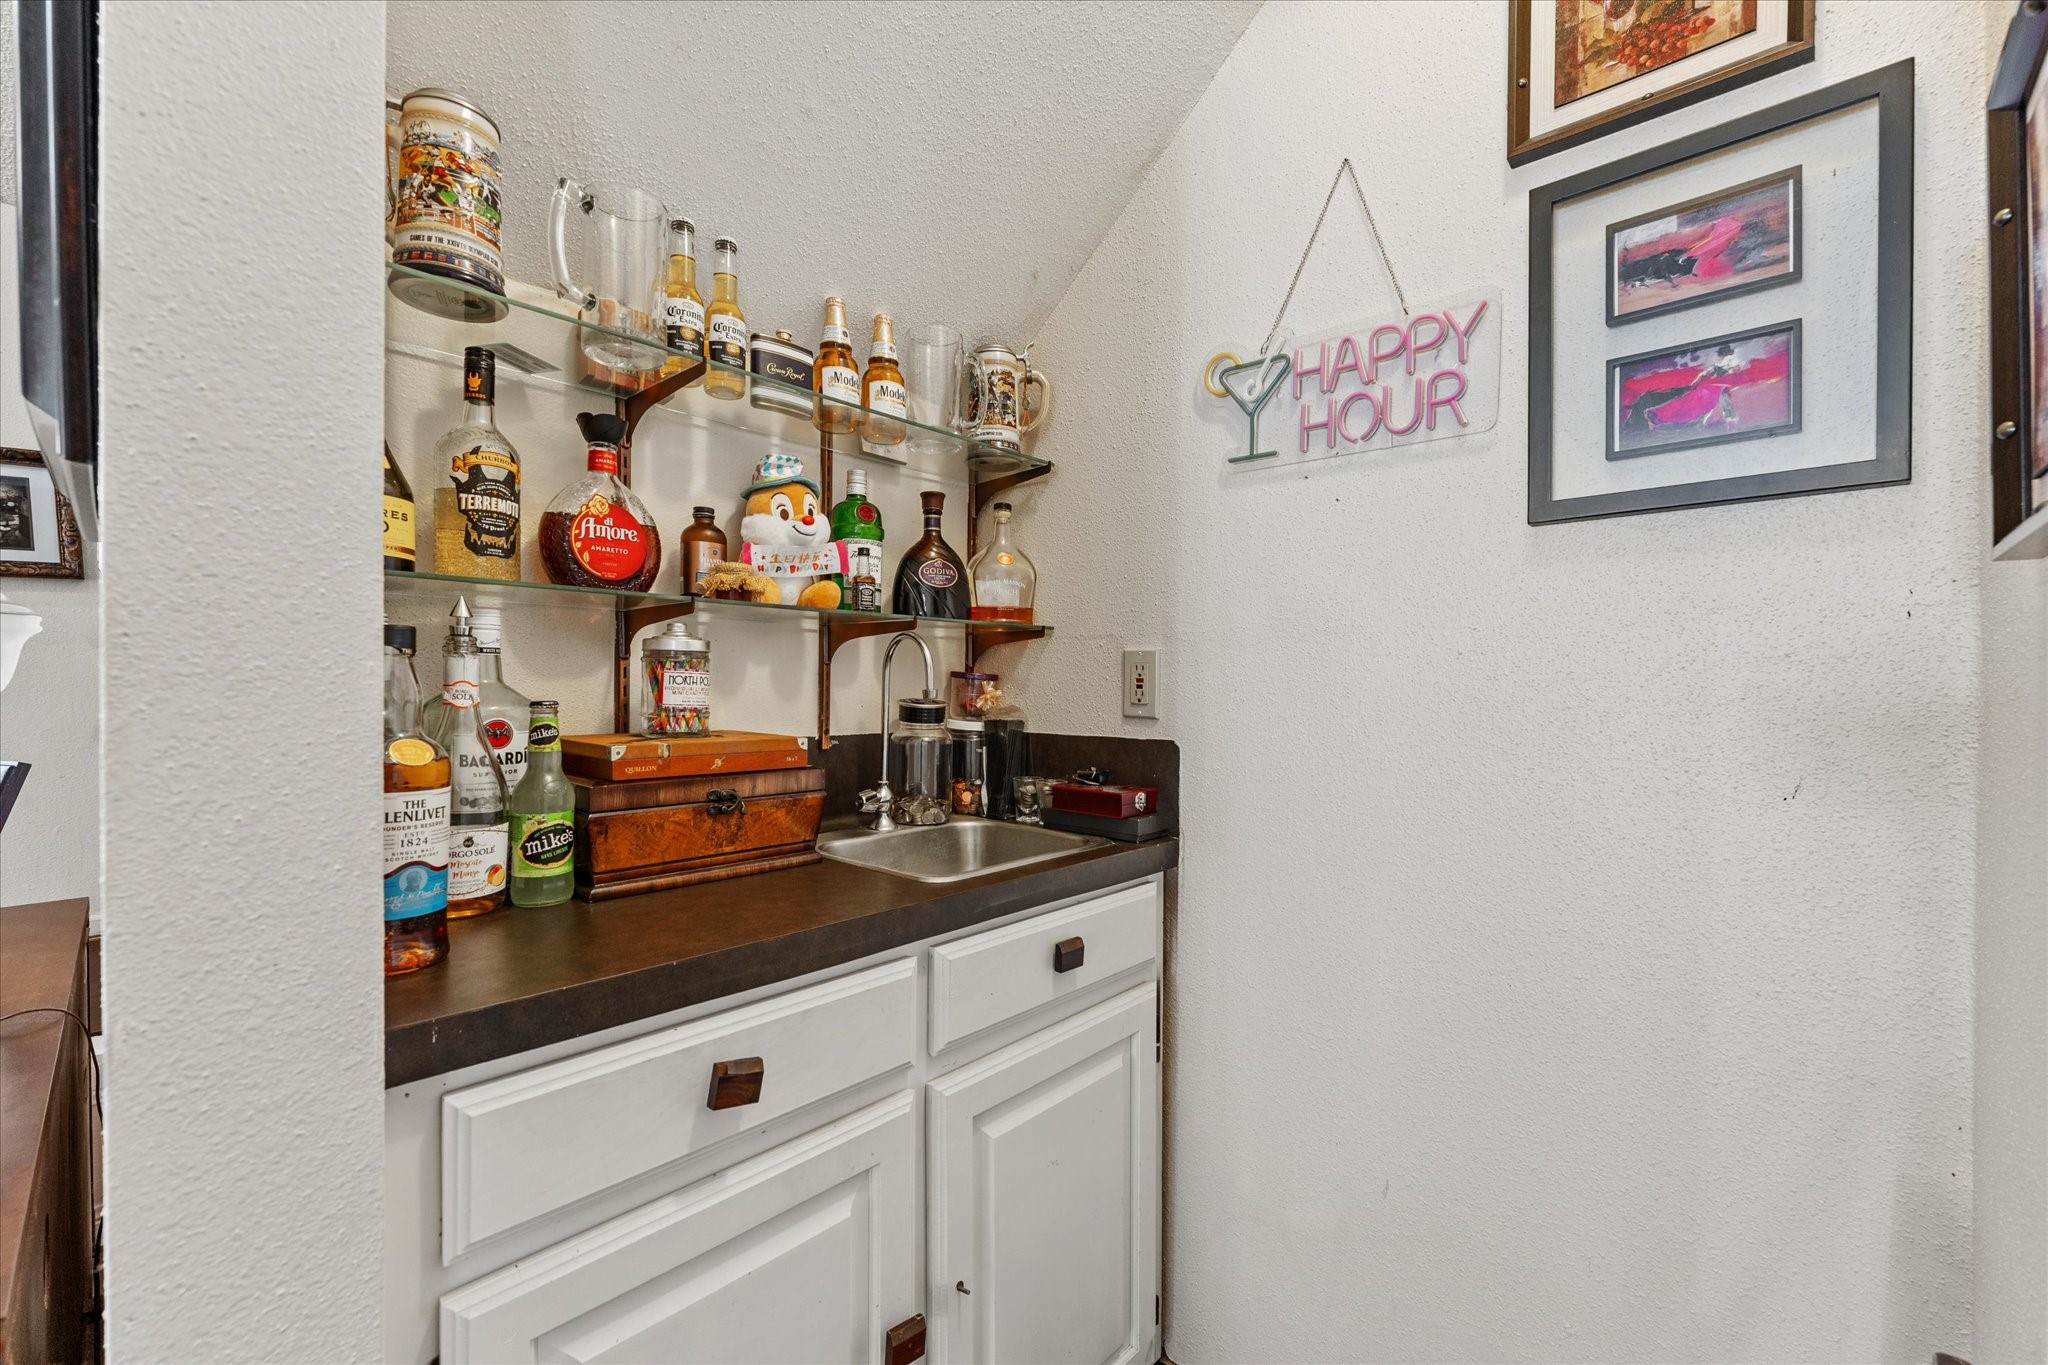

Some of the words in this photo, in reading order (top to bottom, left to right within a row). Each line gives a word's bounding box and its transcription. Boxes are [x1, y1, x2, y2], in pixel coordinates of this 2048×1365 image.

[410, 234, 425, 242] GAMES
[435, 236, 444, 244] THE
[1293, 299, 1488, 400] HAPPY
[766, 362, 786, 378] Crown
[784, 366, 806, 381] Royal
[880, 385, 905, 402] Model
[1300, 368, 1468, 453] HOUR
[604, 516, 614, 527] di
[578, 516, 638, 542] Amore
[590, 544, 629, 555] AMARETTO
[923, 567, 955, 576] GODIVA
[668, 675, 698, 686] NORTH
[699, 676, 710, 687] PO
[530, 727, 558, 741] mike's
[473, 769, 518, 778] SUPIOR
[625, 764, 657, 774] QUILLON
[403, 798, 427, 810] THE
[384, 805, 446, 824] LENLIVET
[385, 824, 418, 832] UNDER'S
[420, 820, 445, 829] RESERVE
[400, 837, 428, 848] 1824
[525, 829, 574, 856] mike's
[384, 855, 414, 863] SCOTCH
[417, 851, 439, 859] WHISKY
[449, 859, 483, 870] Moscato
[452, 870, 480, 880] Mango
